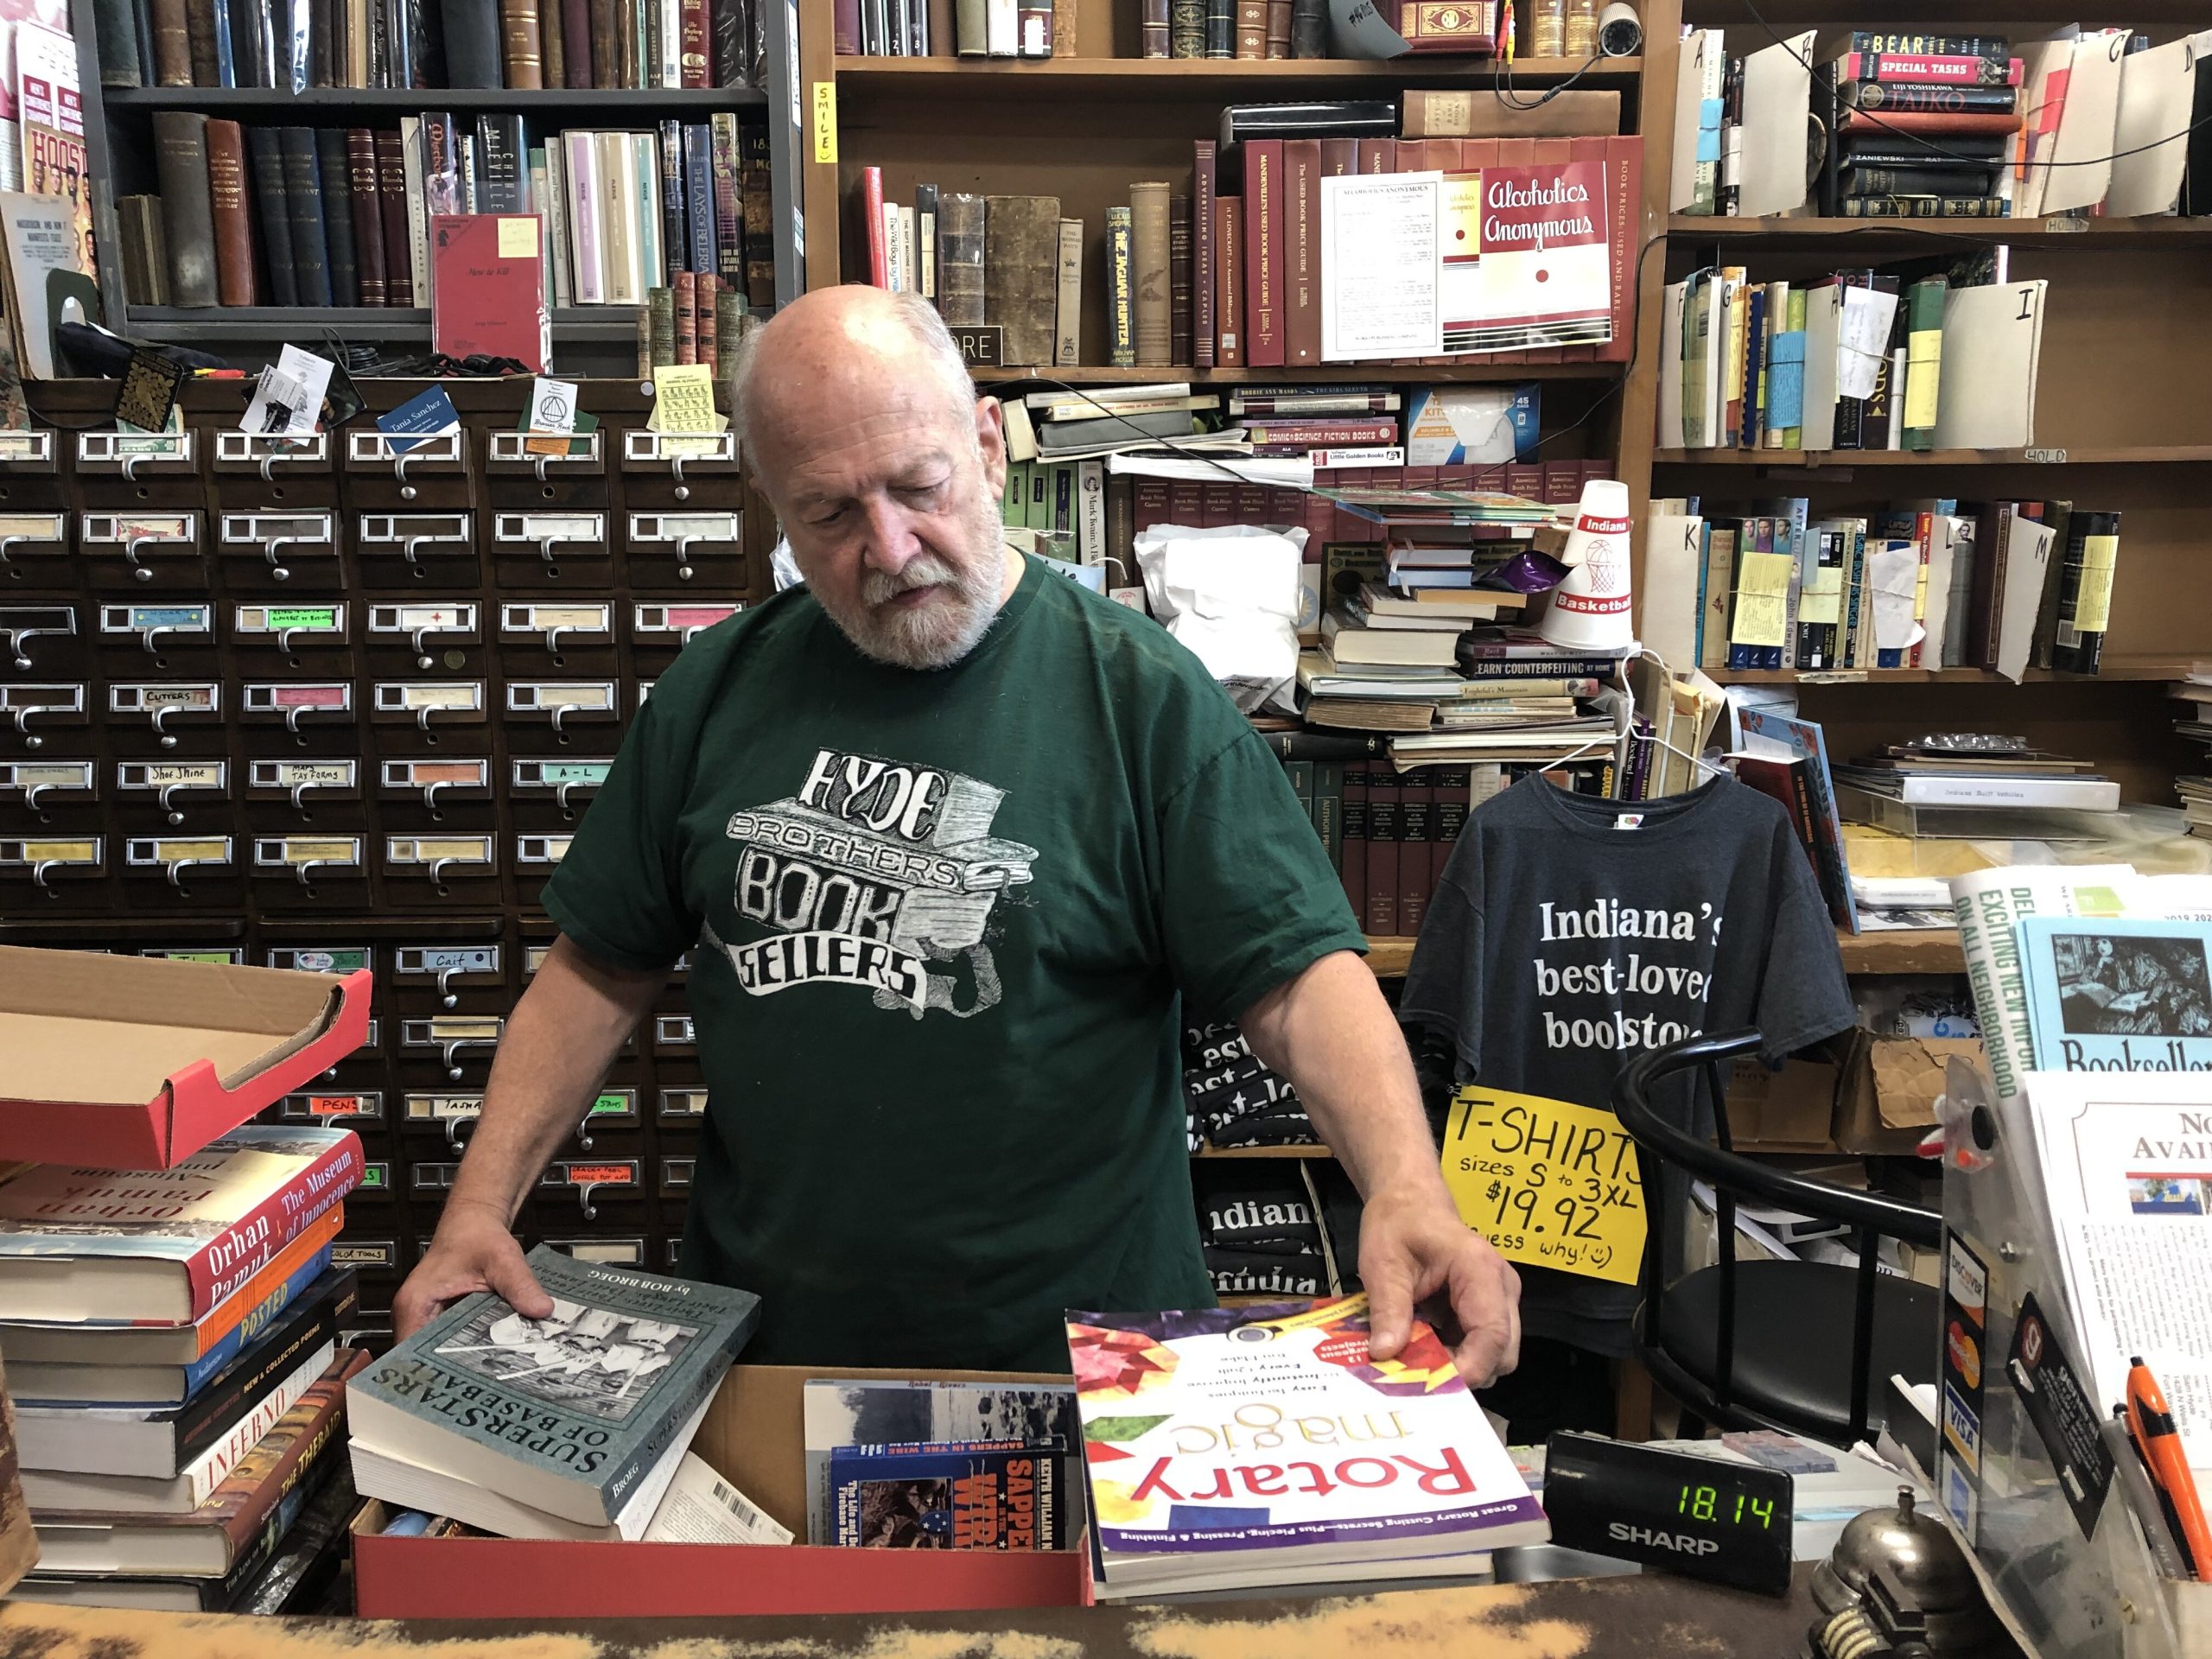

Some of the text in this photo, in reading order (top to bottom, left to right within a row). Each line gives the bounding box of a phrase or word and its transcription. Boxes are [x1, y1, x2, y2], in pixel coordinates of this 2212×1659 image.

[1694, 40, 1704, 69] A
[1801, 35, 1811, 67] B
[1872, 35, 1923, 54] BEAR
[2108, 34, 2126, 61] C
[2184, 48, 2196, 73] D
[1880, 61, 1968, 75] SPECIAL TASKS
[1885, 90, 1967, 112] TAIKO
[1620, 160, 1629, 189] BOOK
[1855, 154, 1905, 162] ZANIEWSKI
[1488, 176, 1590, 209] Alcoholics
[1484, 214, 1595, 253] Anonymous
[1617, 232, 1625, 257] USED
[1615, 260, 1624, 283] AND
[1722, 282, 1731, 308] G
[2016, 289, 2034, 321] I
[390, 399, 442, 433] Tania Sanchez
[1516, 396, 1530, 405] 45
[1294, 432, 1322, 442] SCIENCE
[1324, 431, 1349, 442] FICTION
[1351, 430, 1376, 442] BOOKS
[2026, 449, 2066, 463] HOLD
[1089, 494, 1099, 542] Mark Twain:
[1586, 518, 1627, 532] Indiana
[1684, 523, 1697, 550] K
[2035, 533, 2049, 563] M
[1786, 620, 1796, 653] Edward
[1504, 662, 1585, 675] COUNTERFEITING
[558, 767, 593, 778] A L
[799, 749, 947, 840] HYDE
[730, 814, 961, 888] BROTHERS
[741, 850, 901, 945] BOOK
[435, 954, 466, 968] Cait
[1979, 888, 2018, 1005] EXCITING NEW
[739, 933, 918, 1000] SELLERS
[1955, 894, 2018, 1100] ON ALL NEIGHBORHOOD
[281, 1149, 353, 1218] The Museum
[1460, 1154, 1638, 1210] sizes S to 3XL
[284, 1174, 357, 1244] of Innocence
[1484, 1179, 1604, 1242] $19.92
[208, 1211, 271, 1277] Orhan
[1540, 1241, 1588, 1268] why!
[587, 1269, 691, 1296] by BOB BROEG
[1951, 1254, 1983, 1295] DISCOVER
[239, 1281, 289, 1348] POSTED
[243, 1374, 259, 1395] NEW
[264, 1341, 301, 1376] COLLECTED
[300, 1322, 321, 1345] POEMS
[410, 1357, 611, 1446] OF BASEBALL
[2183, 1374, 2196, 1415] Sam Hyde
[207, 1387, 285, 1491] INFERNO
[373, 1367, 610, 1473] SUPERSTARS
[1169, 1402, 1414, 1457] magic
[1949, 1403, 1975, 1452] VISA
[281, 1409, 342, 1497] THE THEBAID
[887, 1440, 1024, 1455] SAPPERS IN THE WIRE
[612, 1461, 639, 1500] BROEG
[1129, 1446, 1478, 1502] Rotary
[837, 1486, 849, 1525] Firebase
[848, 1480, 858, 1535] The Life and
[1040, 1458, 1052, 1540] KEITH WILLIAM
[1677, 1484, 1774, 1529] 18.14
[1120, 1503, 1518, 1543] Great Rotary Cutting Piecing, Pressing & Finishing
[1608, 1522, 1719, 1556] SHARP
